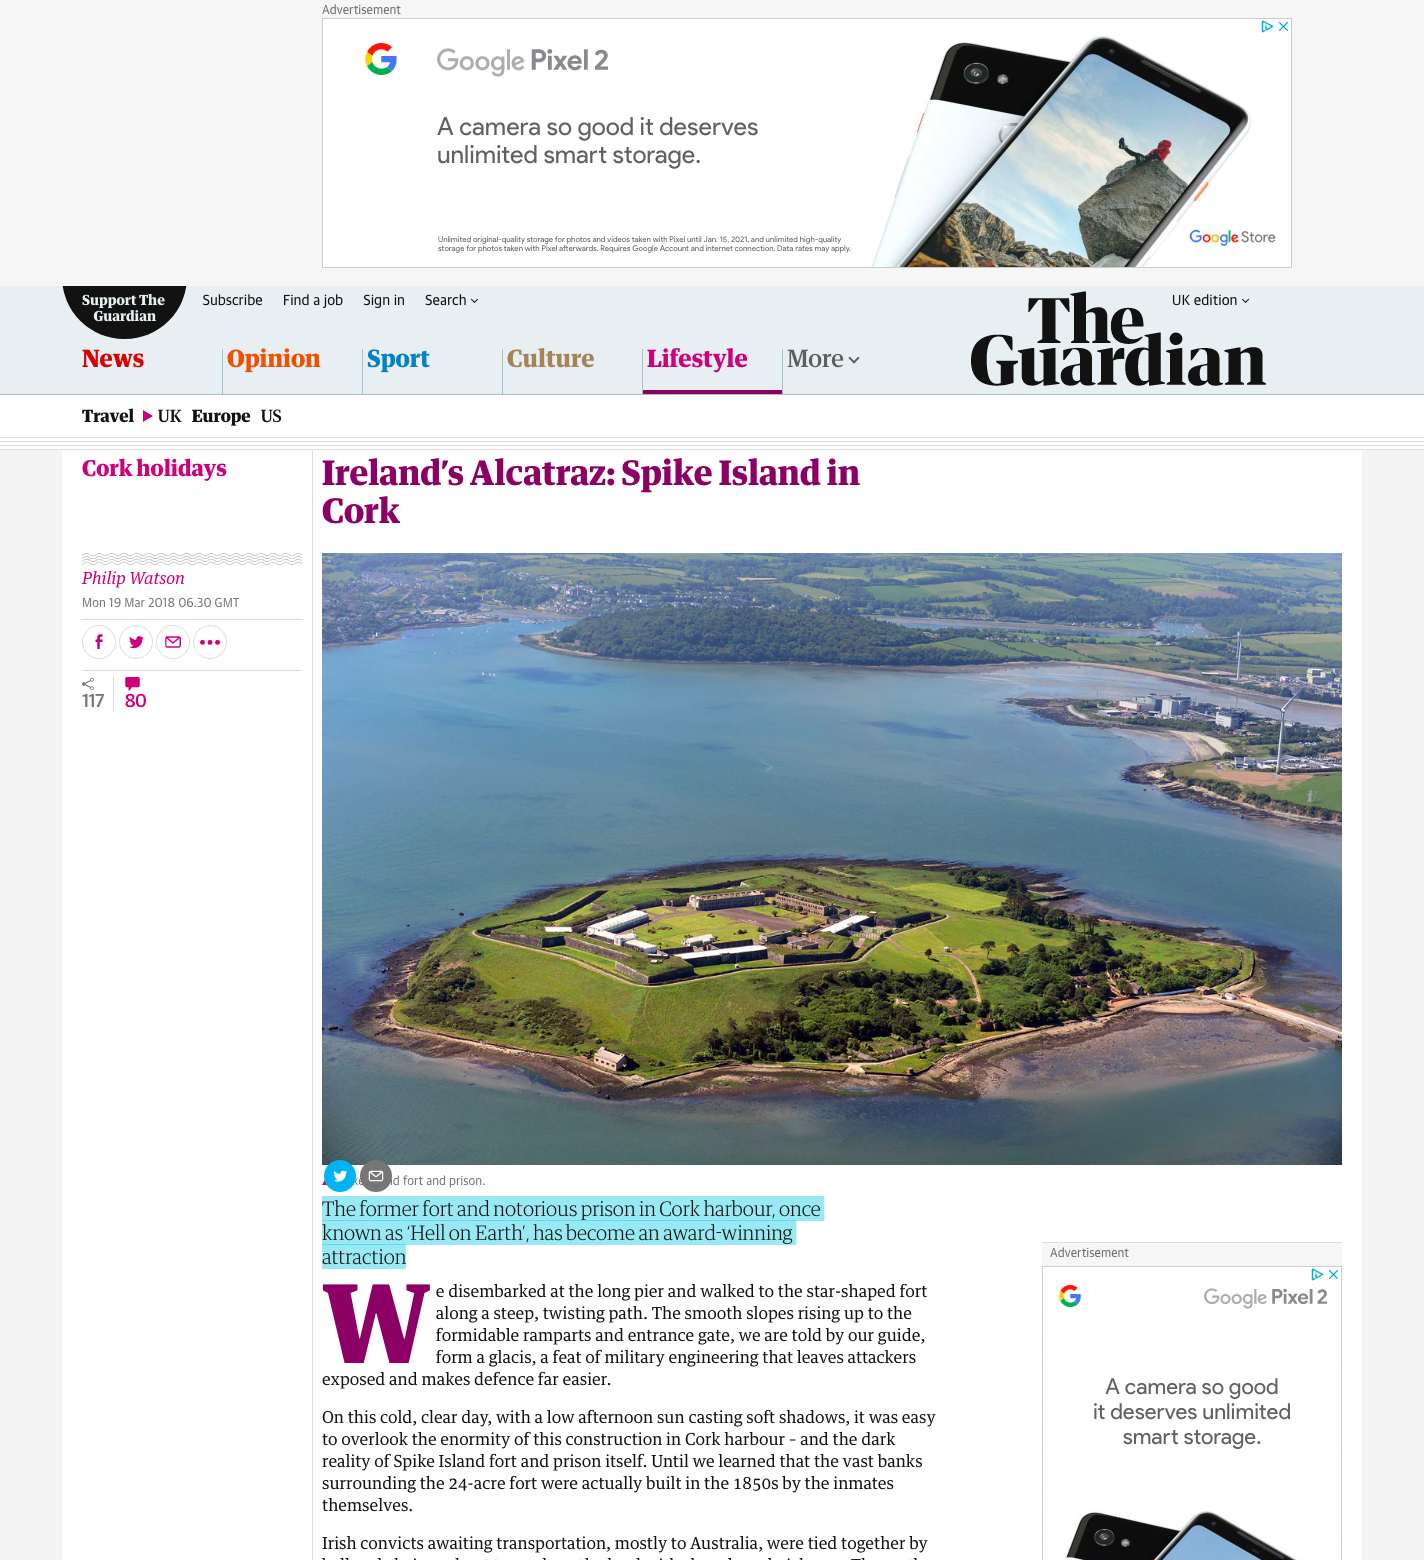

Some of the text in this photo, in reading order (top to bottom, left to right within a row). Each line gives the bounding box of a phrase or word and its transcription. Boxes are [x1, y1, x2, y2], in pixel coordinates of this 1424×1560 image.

[321, 4, 401, 14] Advertisement
[436, 49, 608, 76] Google Pixel 2
[436, 117, 758, 141] A camera so good it deserves
[437, 145, 700, 169] unlimited smart storage.
[1189, 230, 1275, 246] Google Store
[81, 294, 165, 308] Support The
[202, 294, 262, 305] Subscribe
[283, 294, 343, 308] Find a job
[363, 294, 404, 308] Sign in
[424, 294, 466, 305] Search
[1172, 294, 1237, 305] UK edition
[93, 310, 156, 321] Guardian
[1026, 291, 1144, 344] The
[81, 349, 144, 368] News
[226, 348, 321, 372] Opinion
[366, 349, 430, 372] Sport
[506, 348, 594, 368] Culture
[646, 348, 747, 373] Lifestyle
[786, 350, 843, 367] More
[969, 332, 1267, 387] Guardian
[81, 408, 134, 423] Travel
[157, 409, 182, 422] UK
[191, 409, 250, 426] Europe
[260, 409, 281, 422] US
[81, 458, 227, 481] Cork holidays
[321, 458, 860, 493] Ireland’s Alcatraz: Spike Island in
[321, 496, 400, 524] Cork
[81, 571, 184, 588] Philip Watson
[83, 598, 240, 607] Mon 19 Mar 2018 06.30 GMT
[81, 694, 104, 707] 117
[124, 694, 146, 708] 80
[402, 1175, 423, 1185] fort
[426, 1175, 445, 1185] and
[449, 1176, 485, 1188] prison.
[322, 1200, 820, 1221] The former fort and notorious prison in Cork harbour, once
